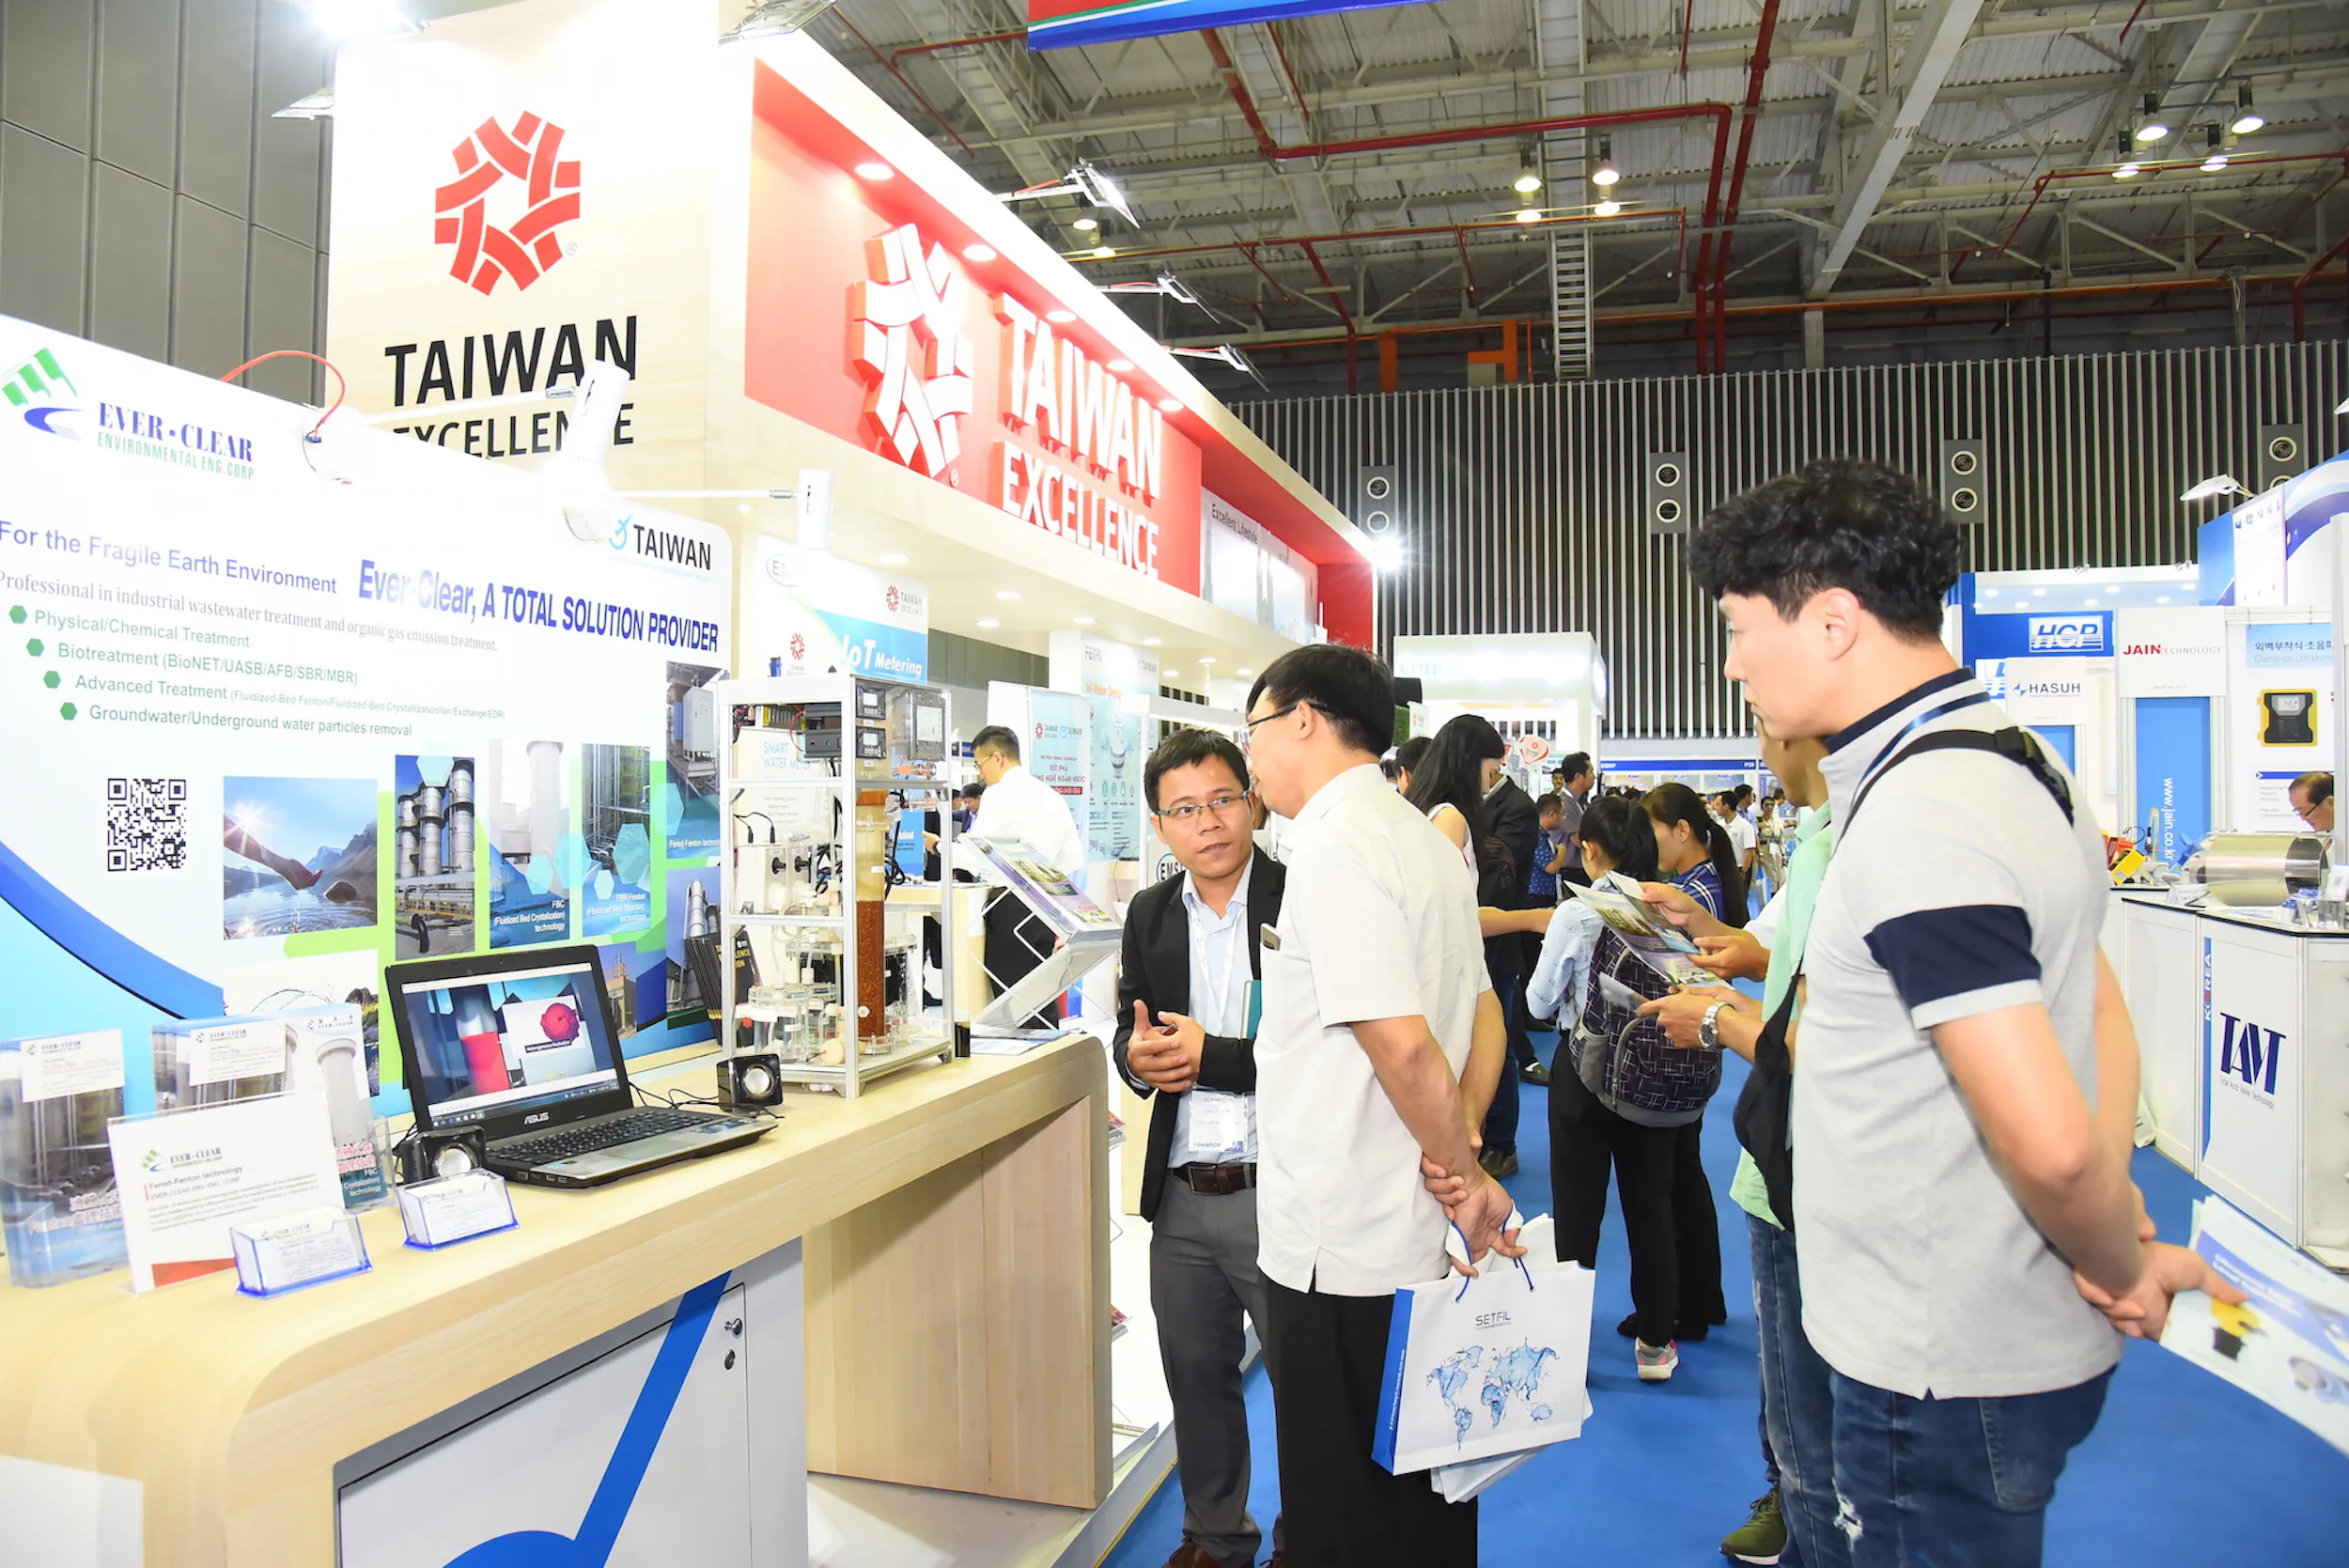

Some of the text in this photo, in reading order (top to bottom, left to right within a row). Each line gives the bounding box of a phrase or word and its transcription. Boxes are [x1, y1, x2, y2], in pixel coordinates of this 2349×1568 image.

[384, 316, 637, 407] TAIWAN
[998, 291, 1163, 502] TAIWAN
[98, 431, 198, 470] ENVIRONMENTAL
[1000, 440, 1159, 581] EXCELLENCE
[1211, 503, 1237, 533] Excellent
[0, 520, 336, 594] For the Fragile Earth Environment
[632, 524, 711, 571] TAIWAN
[35, 609, 251, 648] Physical/Chemical Treatment
[98, 584, 113, 602] in
[117, 587, 185, 612] industrial
[188, 600, 262, 622] wastewater
[264, 611, 322, 629] treatment
[324, 617, 346, 632] and
[347, 621, 386, 639] organic
[388, 627, 405, 642] gas
[407, 629, 450, 646] emission
[451, 635, 498, 652] treatment.
[482, 583, 495, 618] A
[503, 585, 556, 627] TOTAL
[563, 597, 643, 642] SOLUTION
[648, 613, 718, 653] PROVIDER
[58, 642, 358, 687] Biotreatment (BioNET/UASB/AFB/SBR/MBR)
[875, 651, 923, 679] Metering
[75, 674, 153, 694] Advanced
[158, 680, 227, 700] Treatment
[2029, 683, 2081, 693] HASUH
[89, 704, 413, 737] Groundwater/Underground water particles removal
[762, 756, 787, 769] WATER
[763, 741, 789, 755] SMART
[2161, 777, 2176, 862] www.jain.co.kr
[552, 899, 565, 909] FBC
[523, 1111, 551, 1126] ASUS
[148, 1165, 243, 1189] Fered-Fenton technology
[1475, 1312, 1512, 1327] SETFIL
